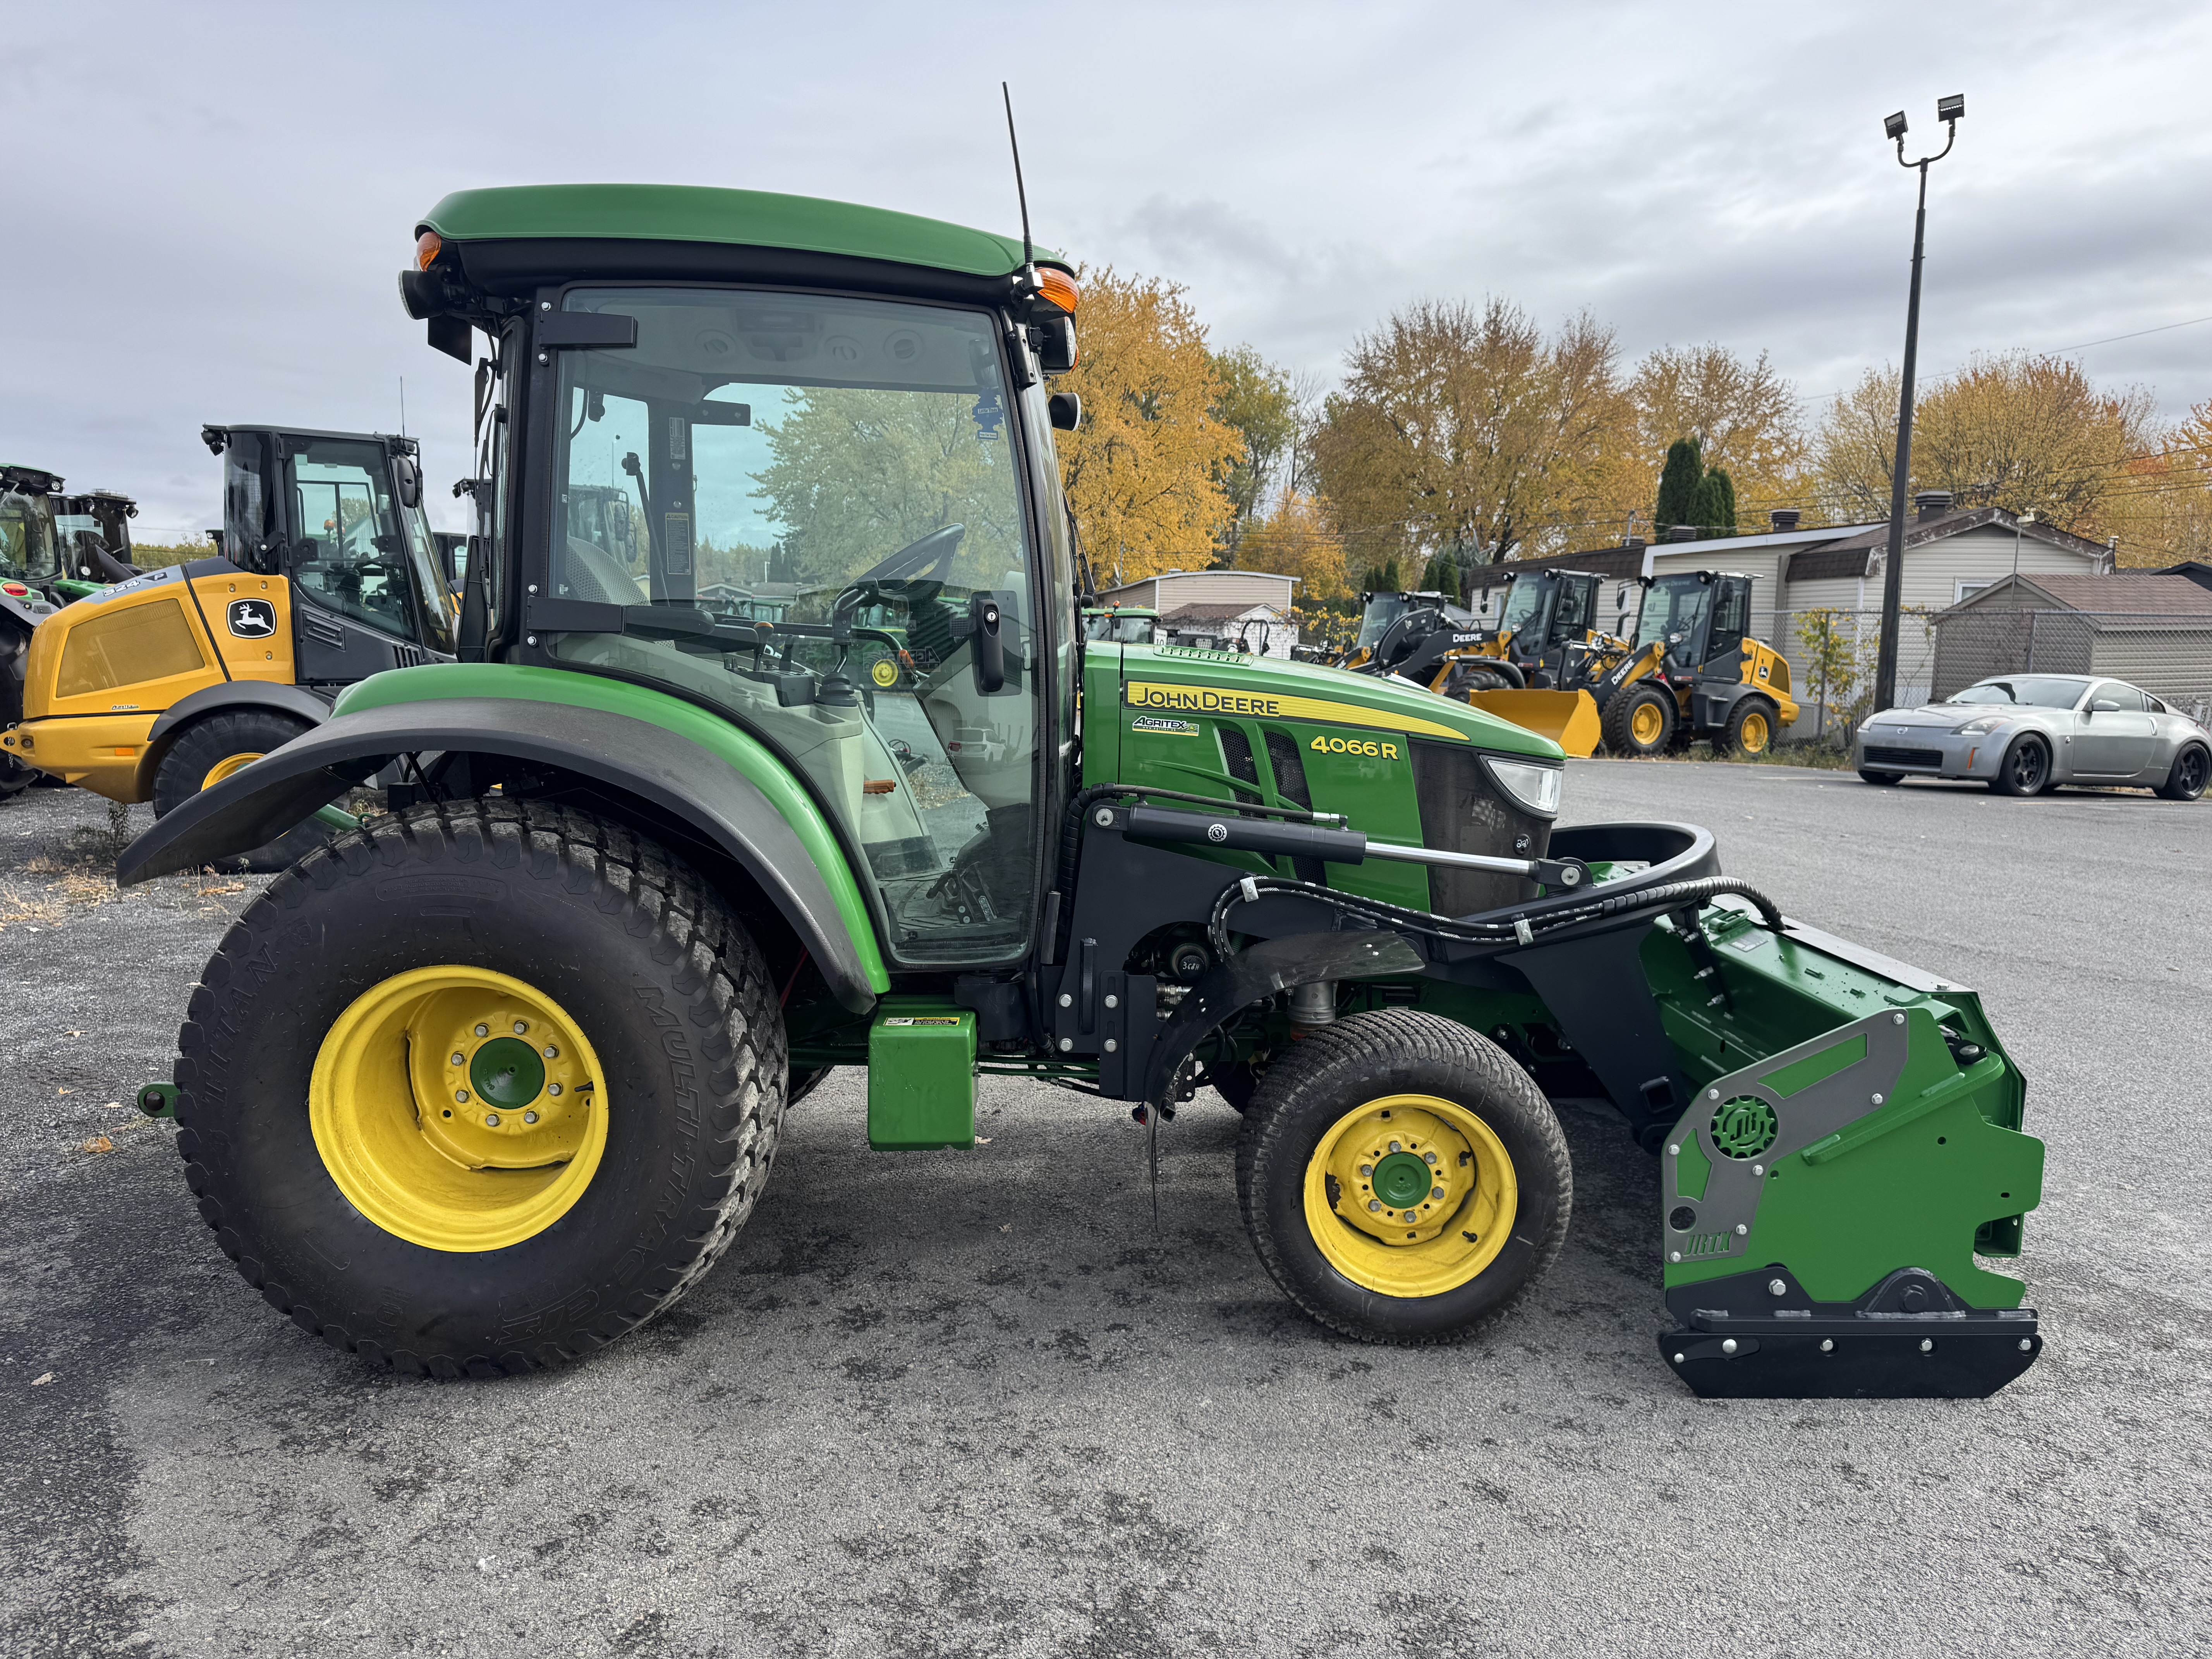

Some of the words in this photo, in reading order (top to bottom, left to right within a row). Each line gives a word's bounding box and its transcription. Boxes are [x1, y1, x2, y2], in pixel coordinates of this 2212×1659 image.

[1453, 633, 1482, 643] DEERE
[1611, 658, 1636, 685] DEERE
[1137, 688, 1197, 708] JOHN
[1202, 692, 1279, 714] DEERE
[1134, 717, 1185, 728] AGRITEX
[1311, 736, 1379, 756] 4066
[1381, 743, 1398, 759] R
[200, 941, 278, 1108] TITAN
[634, 986, 701, 1141] MULTI
[613, 1152, 696, 1285] TRAC
[1683, 1231, 1733, 1256] JRTX
